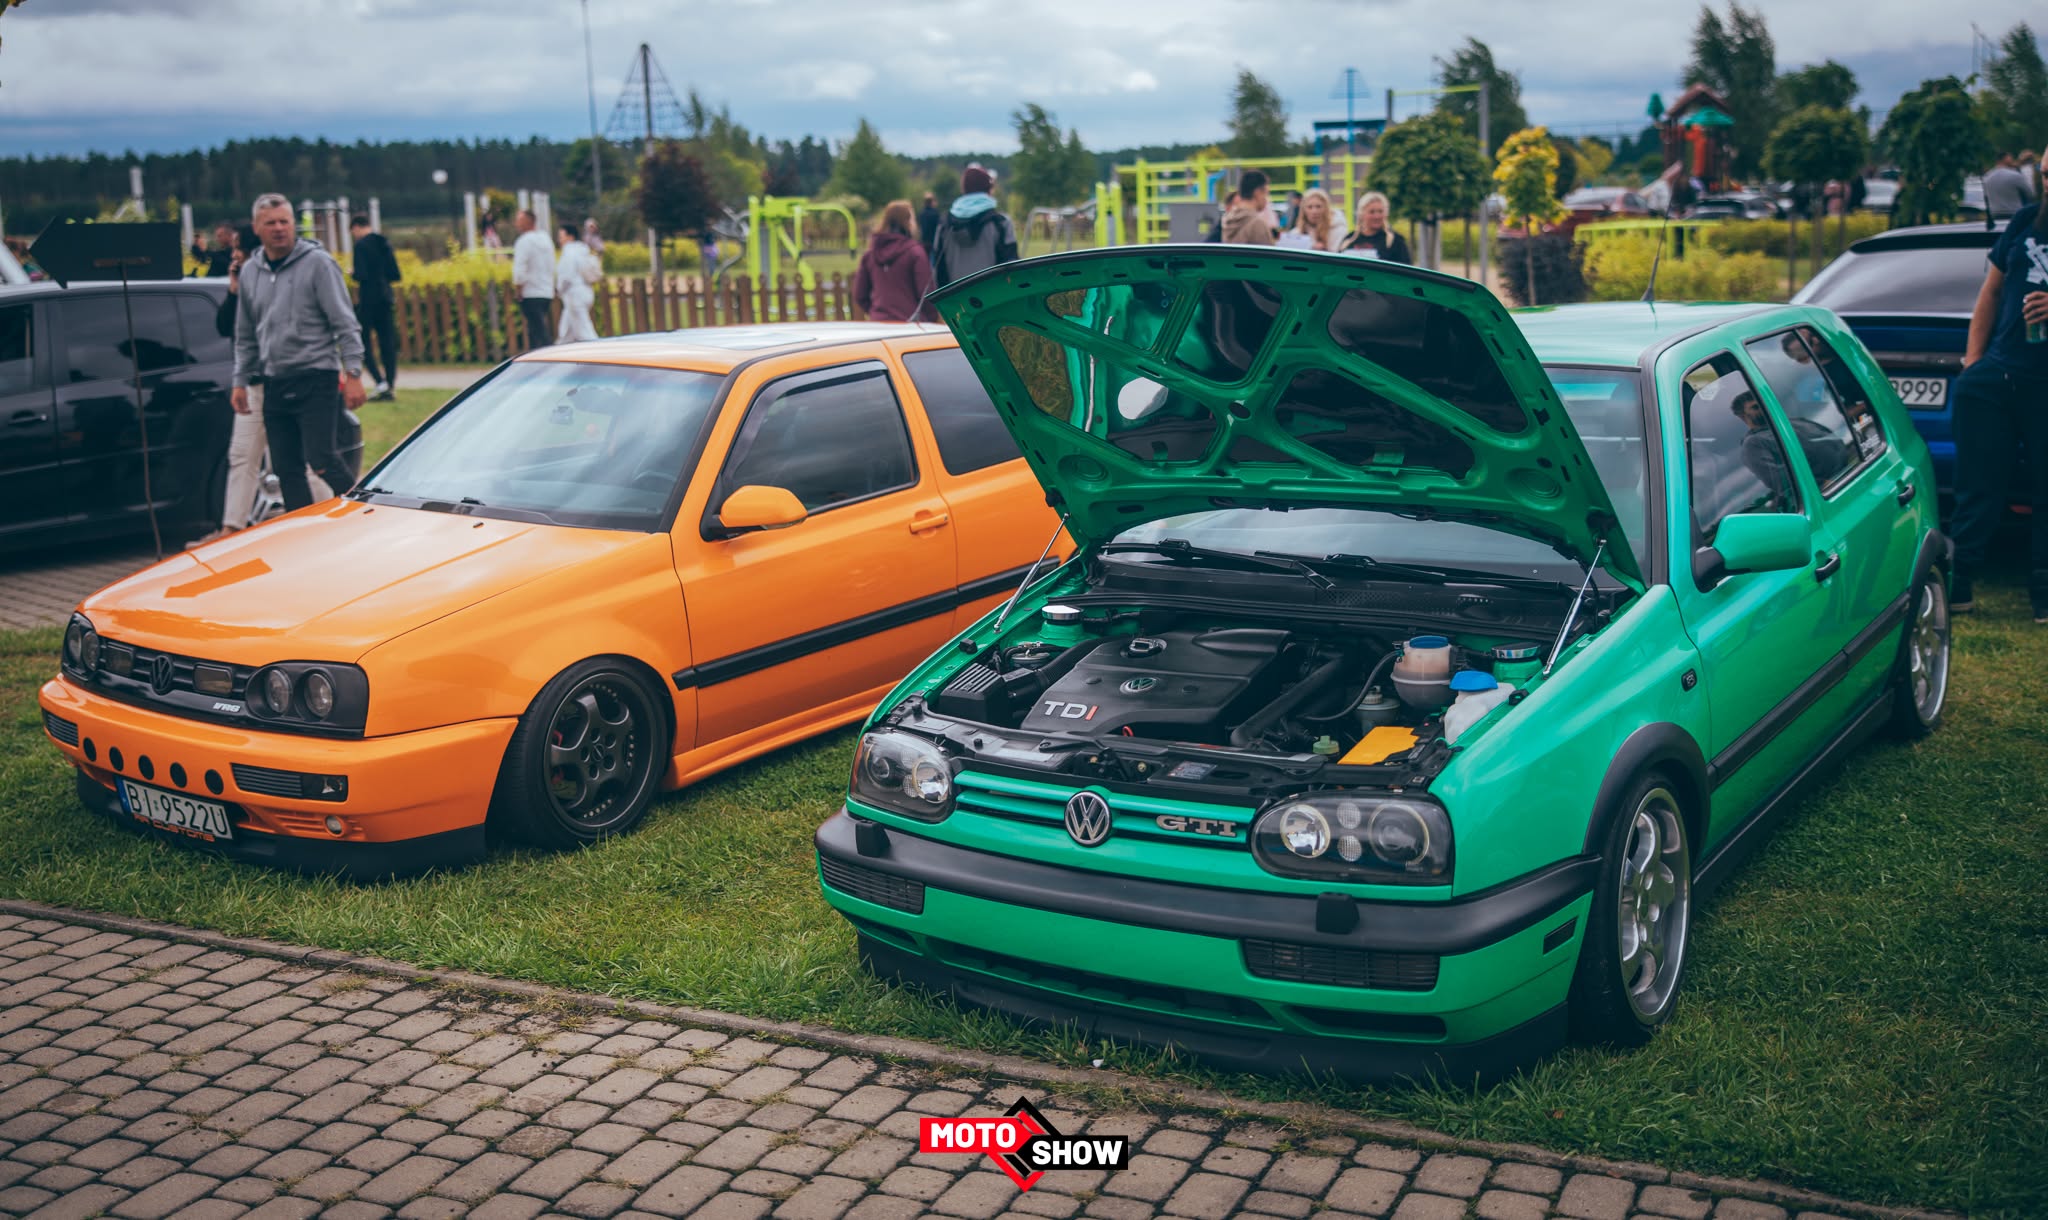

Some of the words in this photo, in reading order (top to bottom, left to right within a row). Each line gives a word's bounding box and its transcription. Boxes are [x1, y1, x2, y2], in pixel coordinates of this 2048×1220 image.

[1044, 700, 1099, 721] TDI
[126, 783, 153, 817] BI
[160, 794, 228, 835] 9522U
[1156, 814, 1237, 838] GTI
